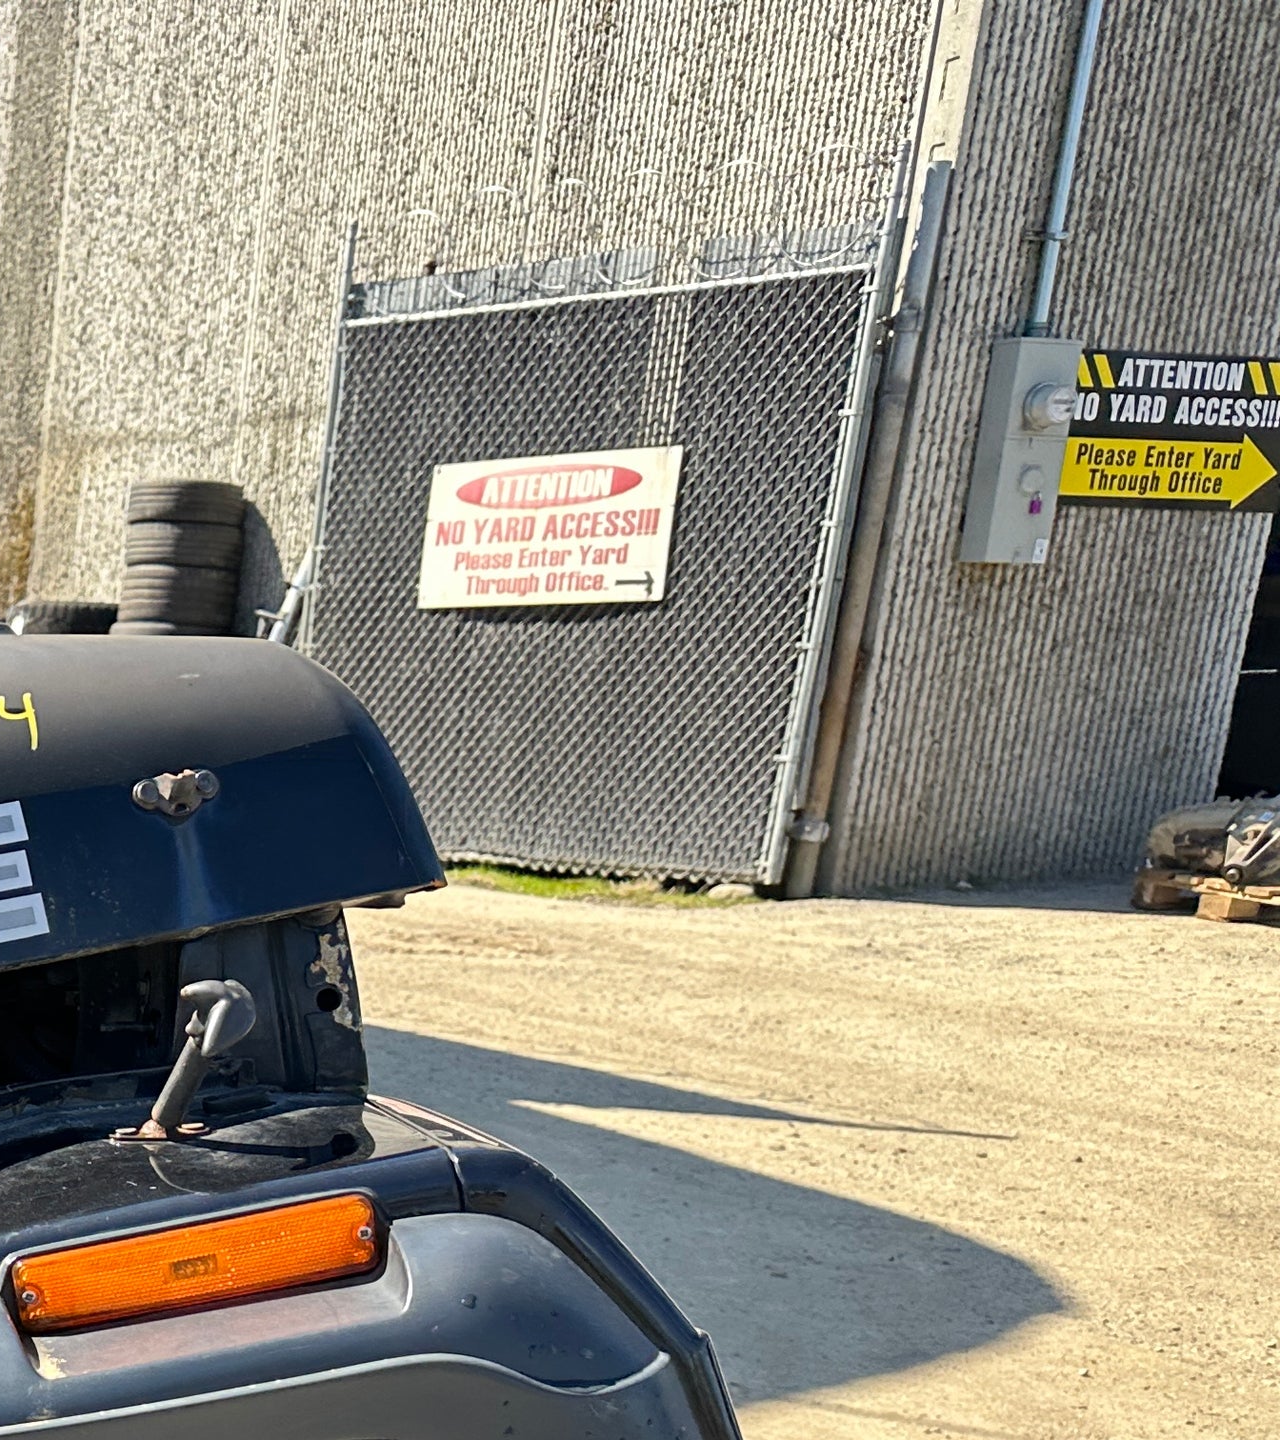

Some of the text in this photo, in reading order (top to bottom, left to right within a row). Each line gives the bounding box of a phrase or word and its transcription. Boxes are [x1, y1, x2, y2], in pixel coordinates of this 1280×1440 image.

[1118, 358, 1245, 392] ATTENTION
[1110, 394, 1167, 424] YARD
[1174, 397, 1280, 428] ACCESS!!!
[1075, 443, 1242, 470] Please Enter Yard
[480, 468, 615, 505] ATTENTION
[1089, 468, 1222, 495] Through Office
[435, 508, 661, 547] NO YARD ACCESS!!!
[454, 543, 629, 571] Please Enter Yard
[466, 575, 539, 597] Through
